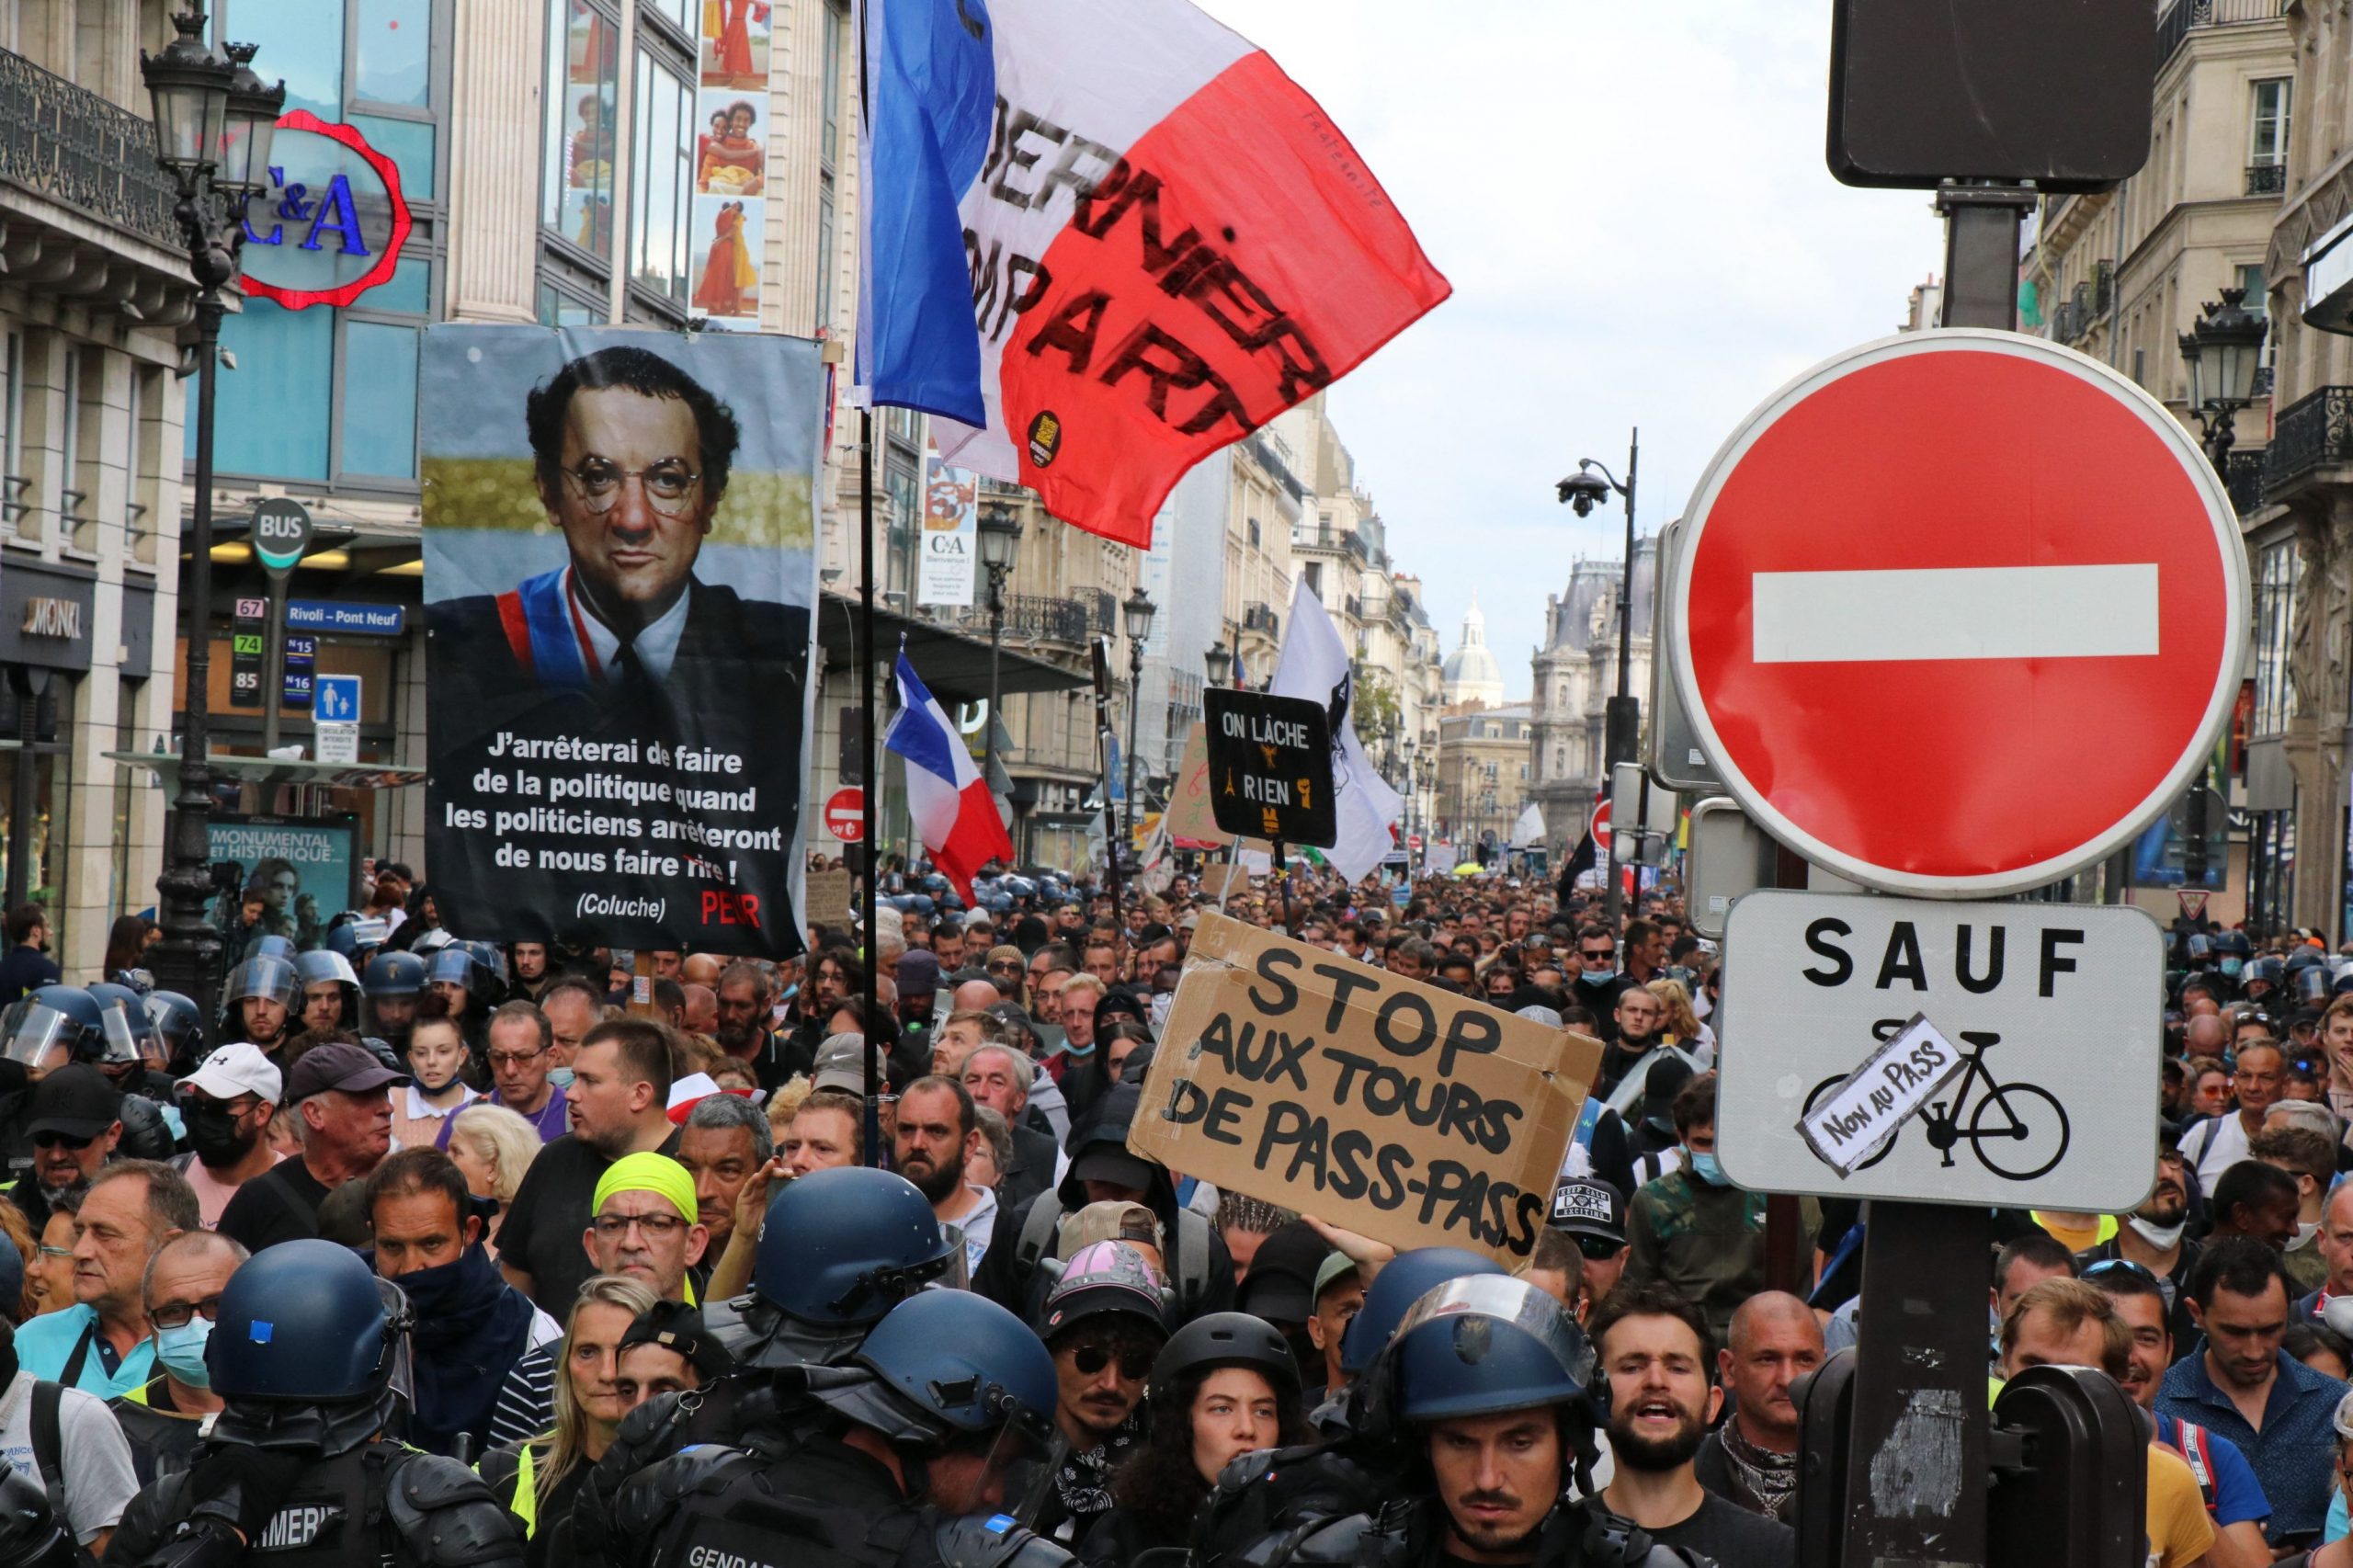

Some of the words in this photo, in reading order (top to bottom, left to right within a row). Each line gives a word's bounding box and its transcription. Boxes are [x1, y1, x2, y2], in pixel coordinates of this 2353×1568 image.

[242, 166, 371, 256] C&A
[260, 515, 302, 538] BUS
[931, 535, 965, 554] C&A
[28, 598, 81, 639] MONKI
[240, 601, 260, 615] 67
[290, 608, 324, 621] Rivoli
[335, 610, 363, 624] Pont
[368, 613, 397, 626] Neuf
[238, 637, 258, 651] 74
[235, 673, 257, 688] 85
[1222, 711, 1245, 738] ON
[1252, 713, 1309, 749] LÂCHE
[646, 740, 670, 767] de
[675, 745, 743, 773] faire
[473, 767, 507, 793] de
[517, 770, 540, 795] la
[550, 773, 671, 806] politique
[676, 787, 756, 812] quand
[1244, 775, 1290, 805] RIEN
[446, 802, 486, 828] les
[495, 806, 642, 837] politiciens
[651, 819, 781, 851] arrêteront
[210, 846, 225, 858] ET
[494, 842, 530, 868] de
[540, 849, 607, 872] nous
[615, 847, 678, 876] faire
[688, 853, 723, 882] rire
[576, 892, 665, 924] (Coluche)
[1802, 916, 2085, 997] SAUF
[1247, 948, 1501, 1077] STOP
[1199, 1012, 1314, 1091] AUX
[1322, 1047, 1523, 1154] TOURS
[1162, 1077, 1253, 1145] DE
[1254, 1100, 1545, 1256] PASS-PASS
[1561, 1187, 1582, 1196] KEEP
[1586, 1188, 1607, 1200] CALM
[1564, 1195, 1603, 1210] DOPE
[1563, 1208, 1604, 1219] EXCITING
